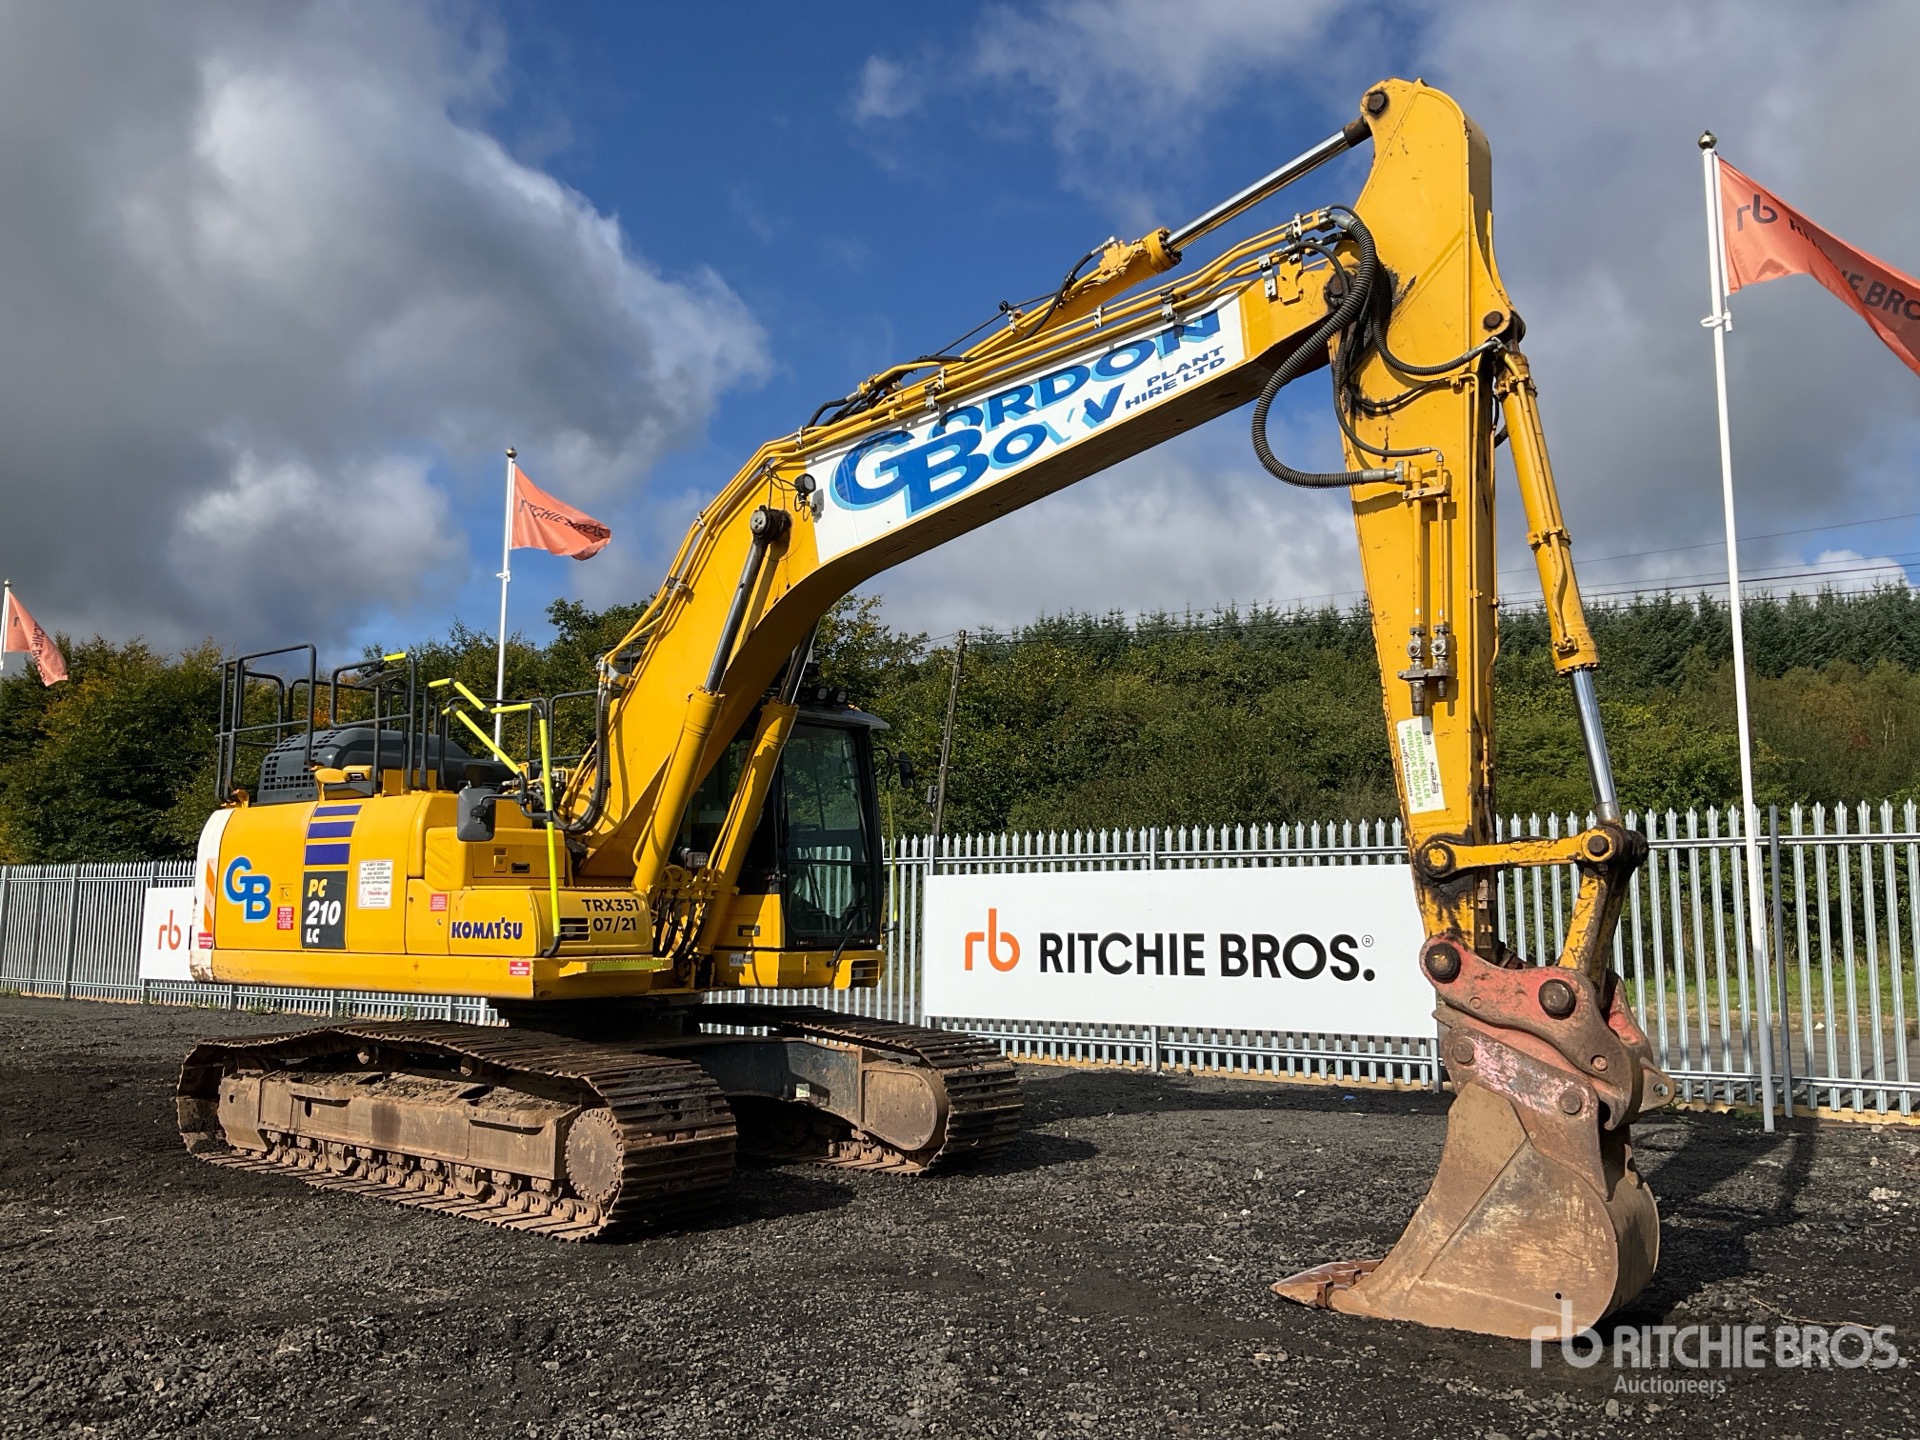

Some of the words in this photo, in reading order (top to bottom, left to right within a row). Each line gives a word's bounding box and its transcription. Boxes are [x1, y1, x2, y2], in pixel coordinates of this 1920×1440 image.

[1736, 194, 1778, 232] rb
[1124, 379, 1177, 411] HIRE
[1181, 356, 1226, 382] LTD
[1146, 345, 1224, 387] PLANT
[1406, 725, 1418, 768] TWINLOCK
[1412, 769, 1424, 808] COUPLER
[1414, 730, 1425, 768] GENUINE
[1421, 767, 1431, 799] MILLER
[224, 855, 272, 923] GB
[307, 878, 328, 898] PC
[581, 898, 640, 912] TRX351
[157, 909, 182, 951] rb
[305, 900, 342, 926] 210
[451, 916, 523, 940] KOMATSU
[593, 916, 637, 934] 07/21
[305, 928, 320, 944] LC
[964, 907, 1021, 973] rb
[1039, 931, 1206, 977] RITCHIE
